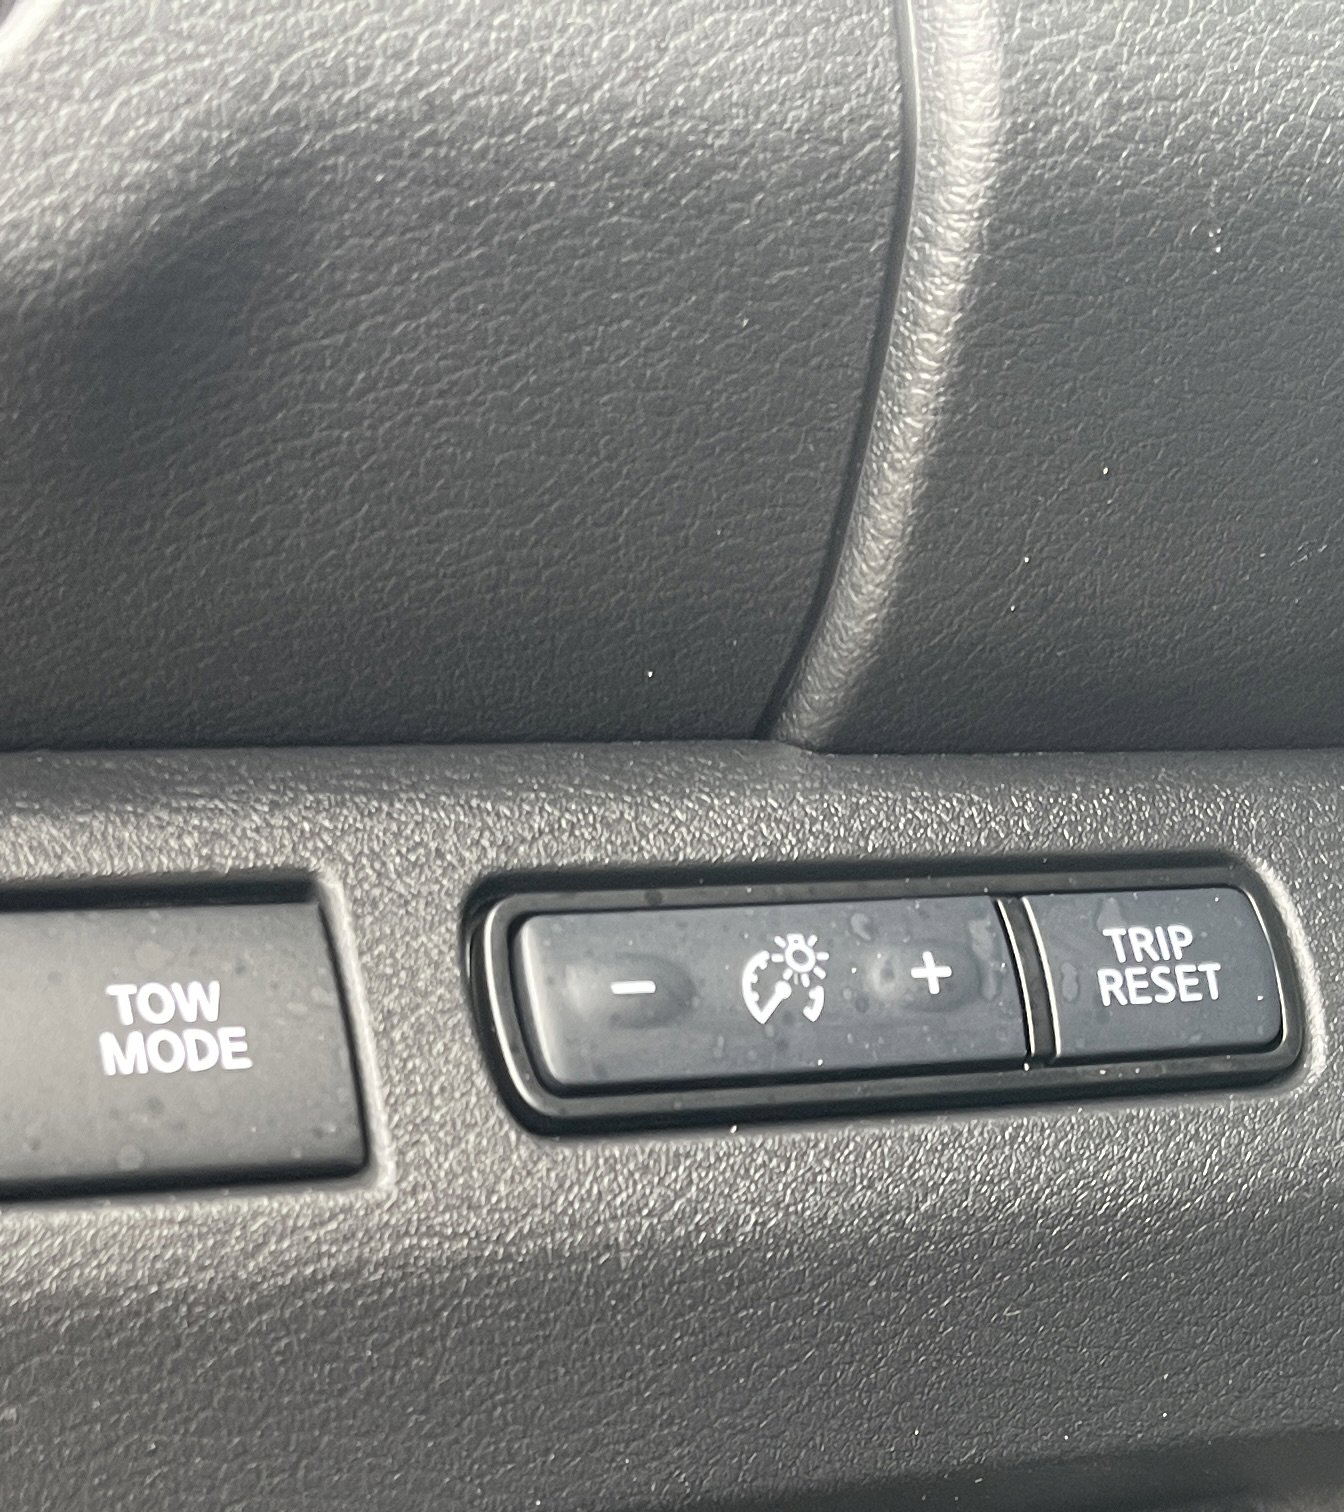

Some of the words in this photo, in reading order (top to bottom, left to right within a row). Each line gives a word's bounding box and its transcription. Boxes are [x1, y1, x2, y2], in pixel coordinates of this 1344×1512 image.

[1102, 924, 1193, 963] TRIP
[105, 980, 221, 1026] TOW
[1097, 962, 1221, 1007] RESET
[99, 1026, 253, 1076] MODE
